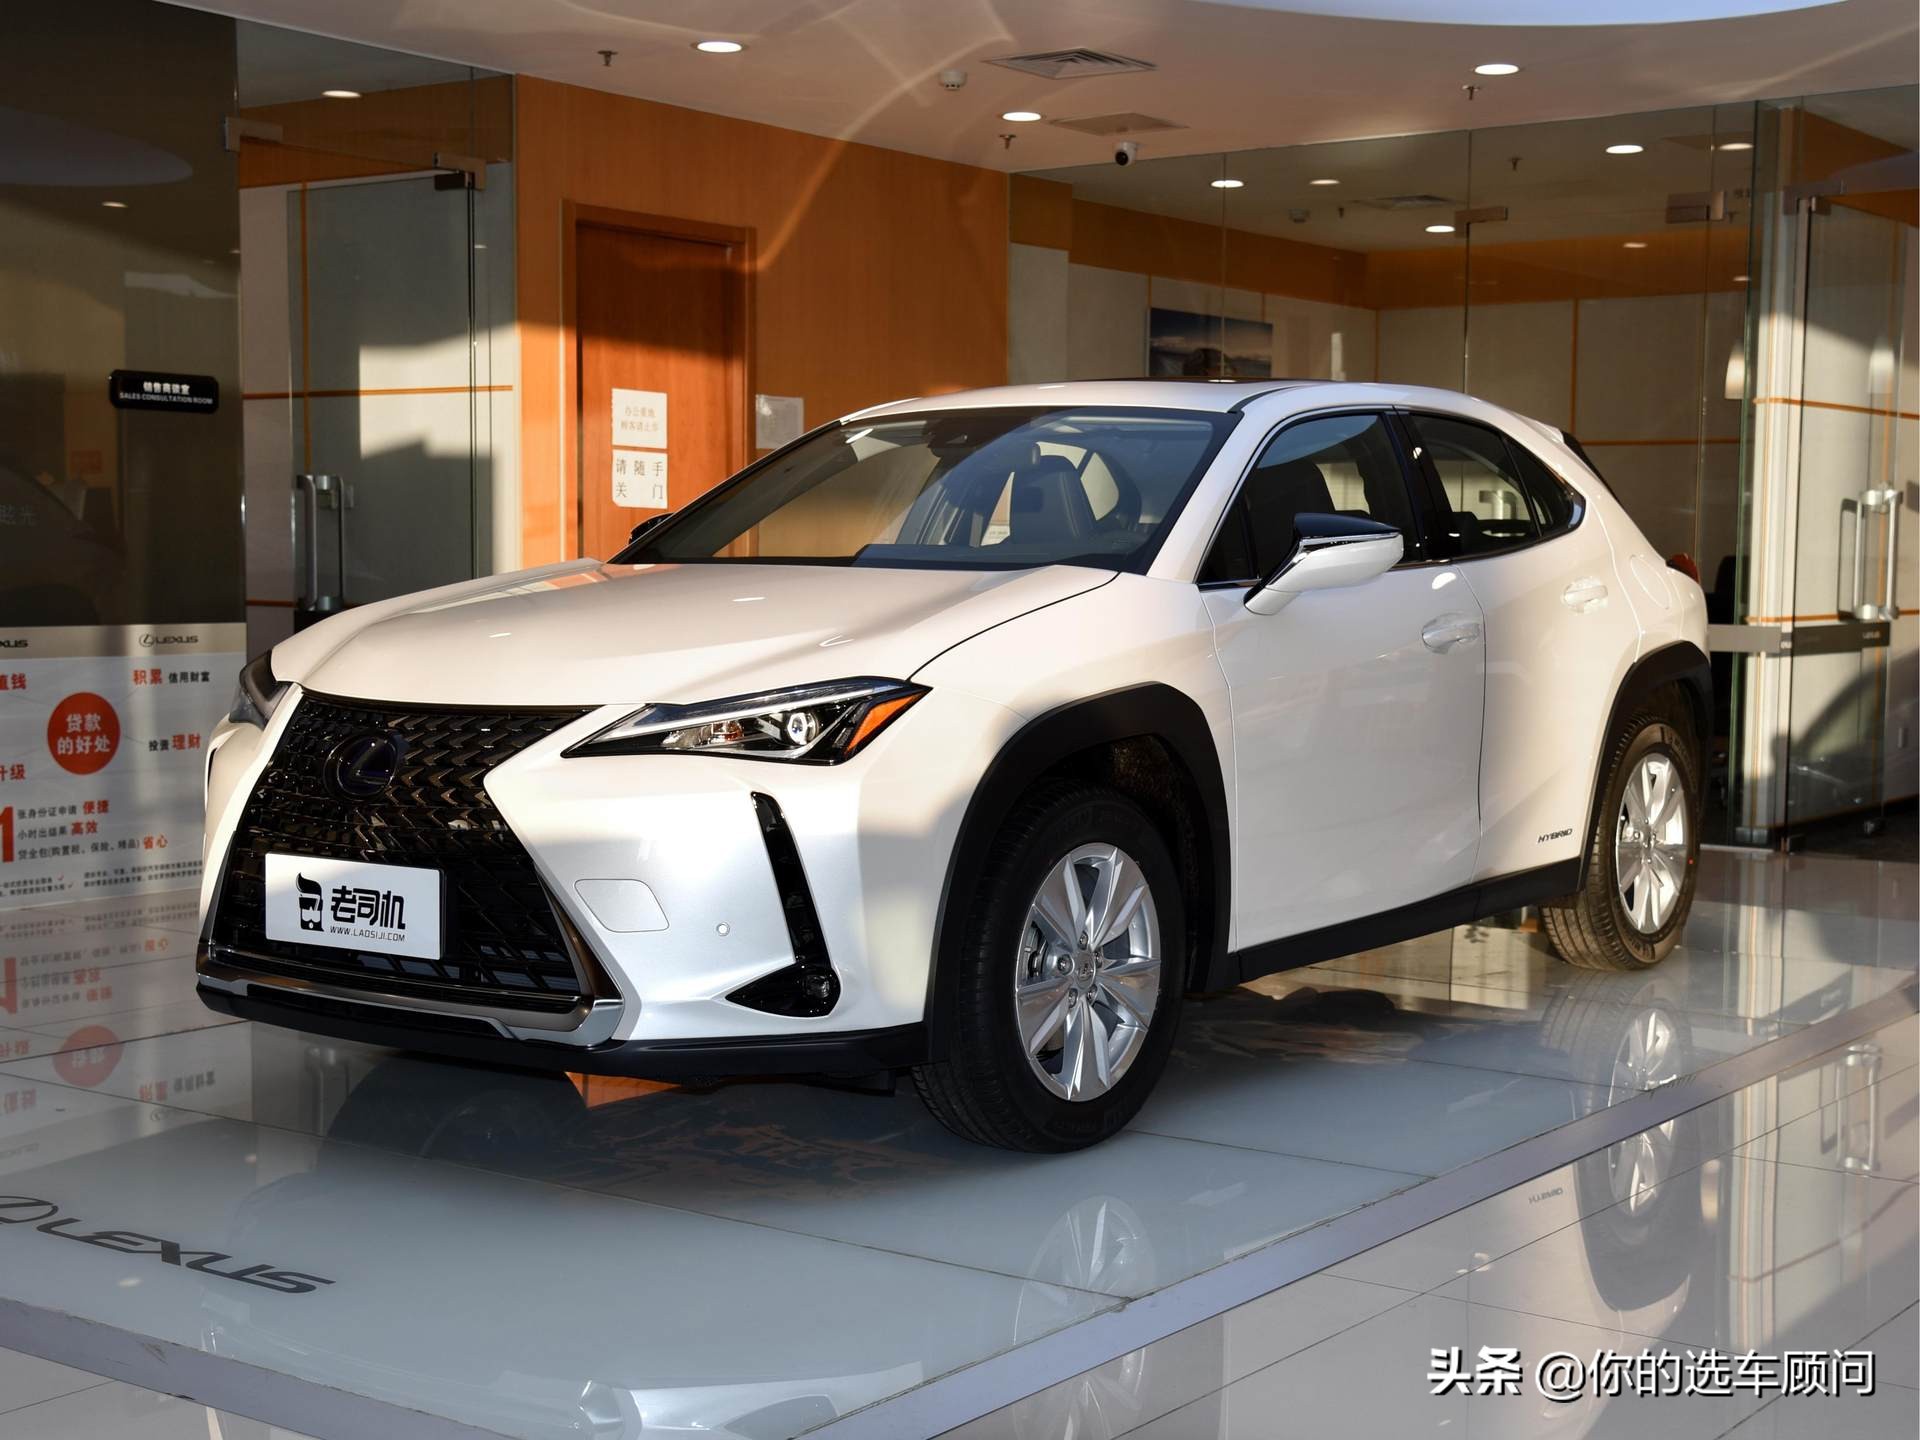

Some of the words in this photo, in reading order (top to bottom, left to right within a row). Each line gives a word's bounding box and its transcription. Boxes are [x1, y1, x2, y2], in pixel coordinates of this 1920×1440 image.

[155, 635, 199, 645] LEXUS
[133, 668, 163, 685] 积累
[168, 671, 210, 684] 信用财富
[66, 713, 101, 733] 贷款
[57, 735, 111, 755] 的好处
[172, 734, 201, 750] 理财
[82, 799, 109, 815] 便捷
[71, 820, 98, 836] 高效
[1537, 828, 1573, 843] HYBRID
[143, 835, 168, 849] 省心
[330, 885, 406, 930] 老司机
[329, 925, 406, 942] WWW.LAOSIJI.COM
[36, 1217, 336, 1294] LEXUS
